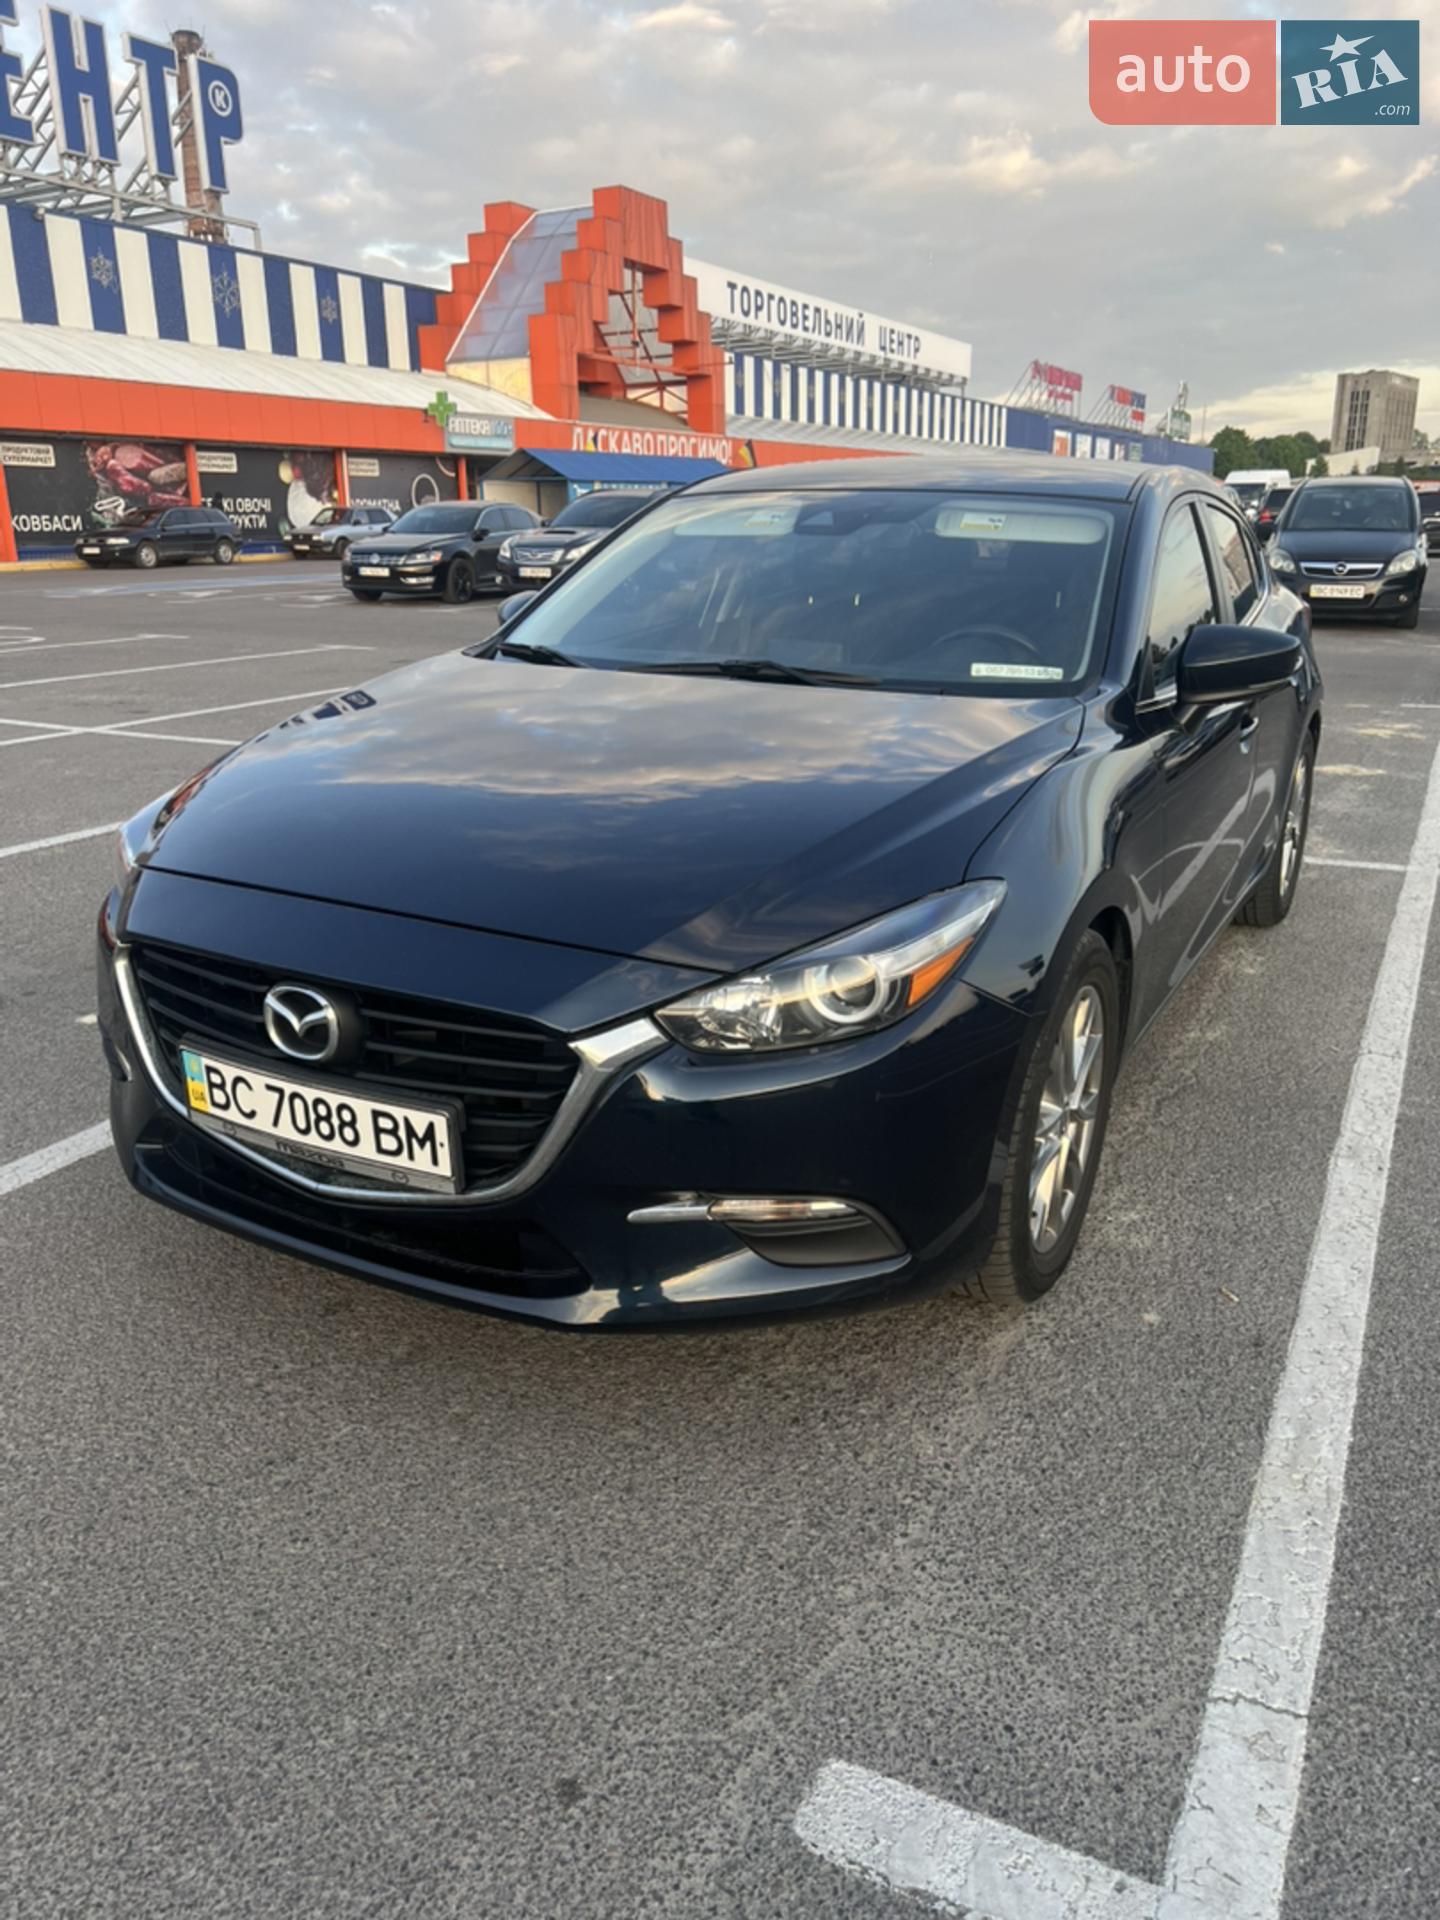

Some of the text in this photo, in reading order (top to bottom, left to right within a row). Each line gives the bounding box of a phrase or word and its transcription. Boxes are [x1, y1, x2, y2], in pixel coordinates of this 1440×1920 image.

[726, 280, 922, 360] ТОРГОВЕЛЬНИЙ ЦЕНТР
[11, 514, 83, 532] КОВБАСИ
[228, 513, 268, 529] РУКТИ
[205, 1064, 439, 1167] BC 7088 BM
